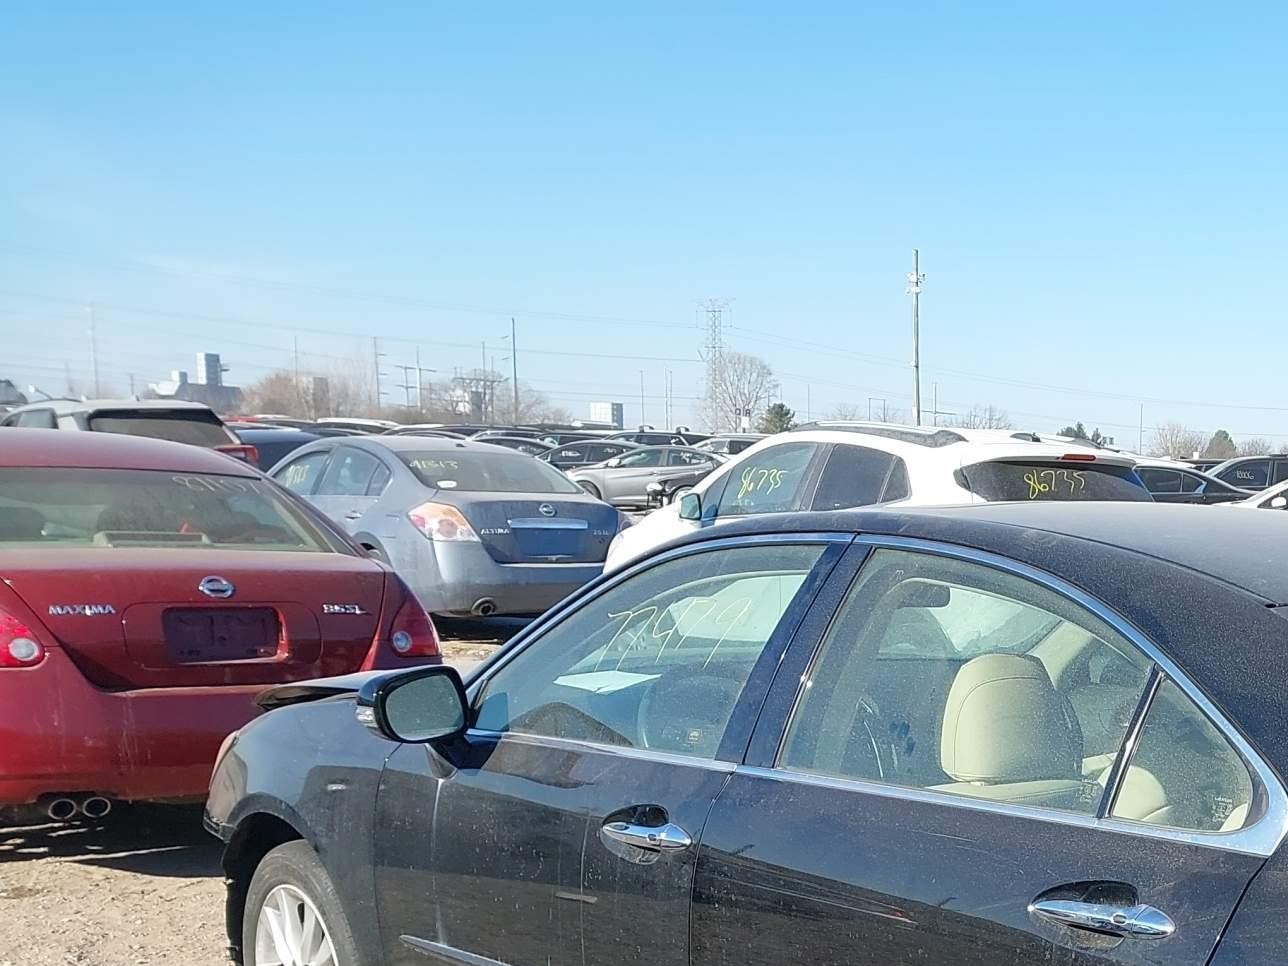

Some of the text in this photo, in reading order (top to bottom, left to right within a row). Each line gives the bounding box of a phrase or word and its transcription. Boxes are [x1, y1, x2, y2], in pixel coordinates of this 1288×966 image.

[737, 466, 789, 499] 86735
[1023, 469, 1088, 499] 86735
[48, 604, 117, 616] MAXIMA
